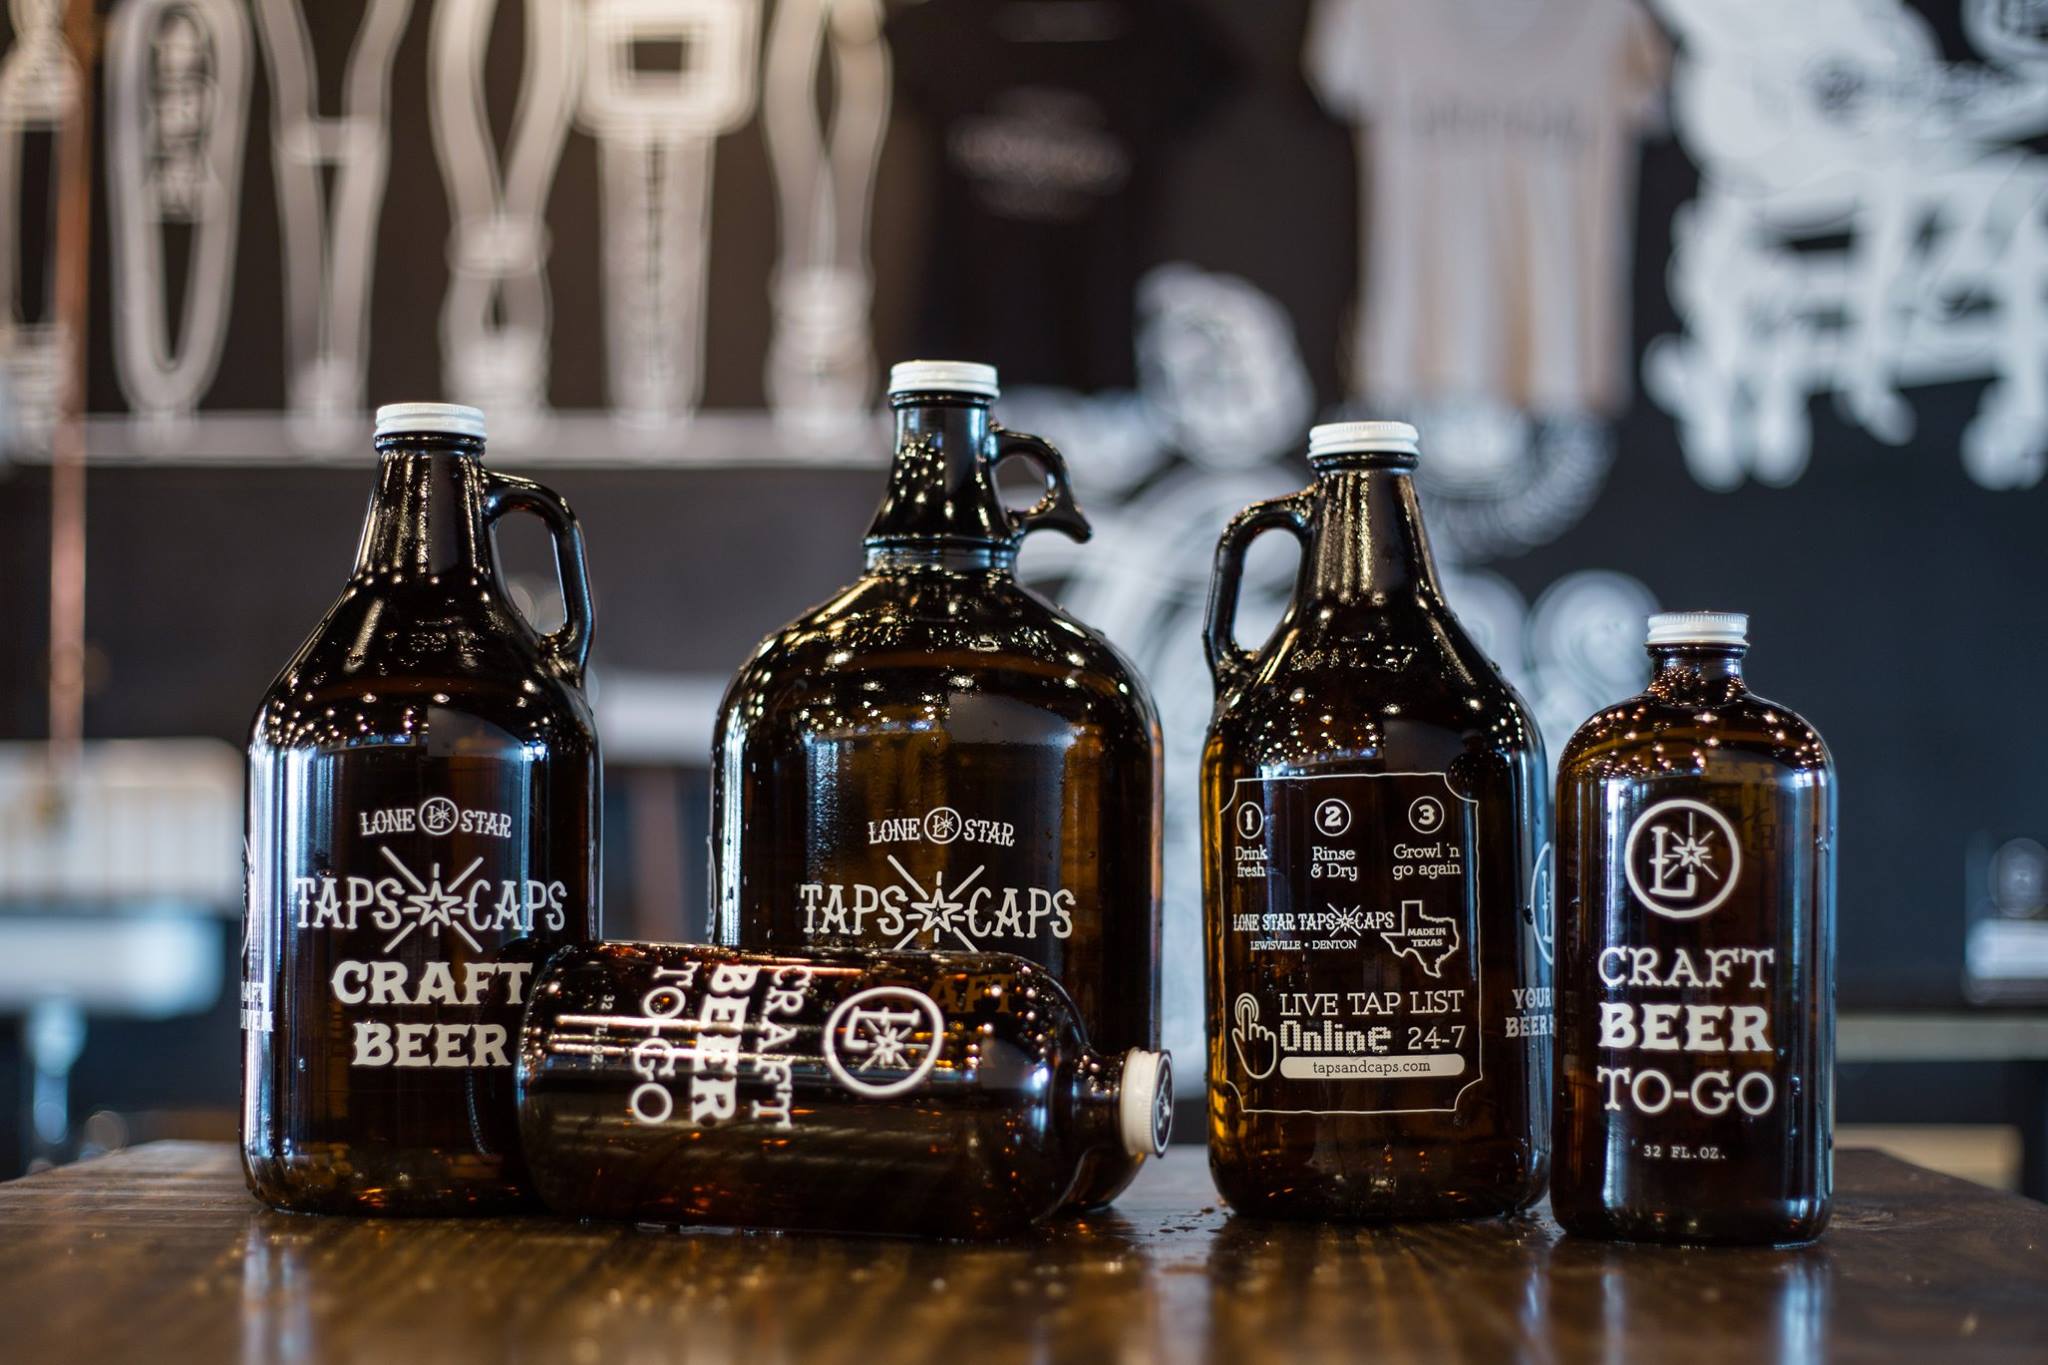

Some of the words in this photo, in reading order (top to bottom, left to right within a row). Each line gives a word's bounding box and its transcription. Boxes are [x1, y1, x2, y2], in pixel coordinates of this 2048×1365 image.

[360, 808, 416, 836] LONE
[460, 810, 512, 838] STAR
[868, 818, 921, 845] LONE
[963, 818, 1015, 847] STAR
[1235, 845, 1268, 861] Drink
[1312, 846, 1356, 861] Rinse
[1393, 843, 1442, 859] Growl
[1237, 862, 1266, 878] fresh
[1310, 863, 1323, 879] &
[1327, 863, 1358, 882] Dry
[1392, 865, 1414, 880] go
[1418, 861, 1461, 879] again
[294, 876, 405, 931] TAPS
[464, 878, 568, 932] CAPS
[800, 883, 909, 936] TAPS
[964, 886, 1076, 939] CAPS
[1233, 913, 1261, 931] LONE
[1262, 912, 1296, 931] STAR
[1298, 912, 1336, 931] TAPS
[1354, 911, 1395, 930] CAPS
[1407, 927, 1435, 937] MADE
[1250, 940, 1301, 951] LEWISVILLE
[1312, 939, 1357, 950] DENTON
[1411, 938, 1443, 948] TEXAS
[1598, 945, 1775, 989] CRAFT
[330, 961, 533, 1005] CRAFT
[600, 994, 616, 1010] 32
[1279, 993, 1339, 1016] LIVE
[1347, 992, 1401, 1015] TAP
[1409, 990, 1465, 1014] LIST
[1511, 987, 1552, 1009] YOUR
[1280, 1019, 1392, 1052] Online
[1407, 1025, 1466, 1051] 24-7
[1598, 1002, 1774, 1052] BEER
[352, 1022, 513, 1068] BEER
[630, 961, 702, 1125] TO-GO
[691, 963, 761, 1128] BEER
[751, 965, 813, 1129] CRAFT
[1313, 1059, 1431, 1078] tapsandcaps.com
[1597, 1065, 1775, 1116] TO-GO
[1643, 1145, 1662, 1158] 32
